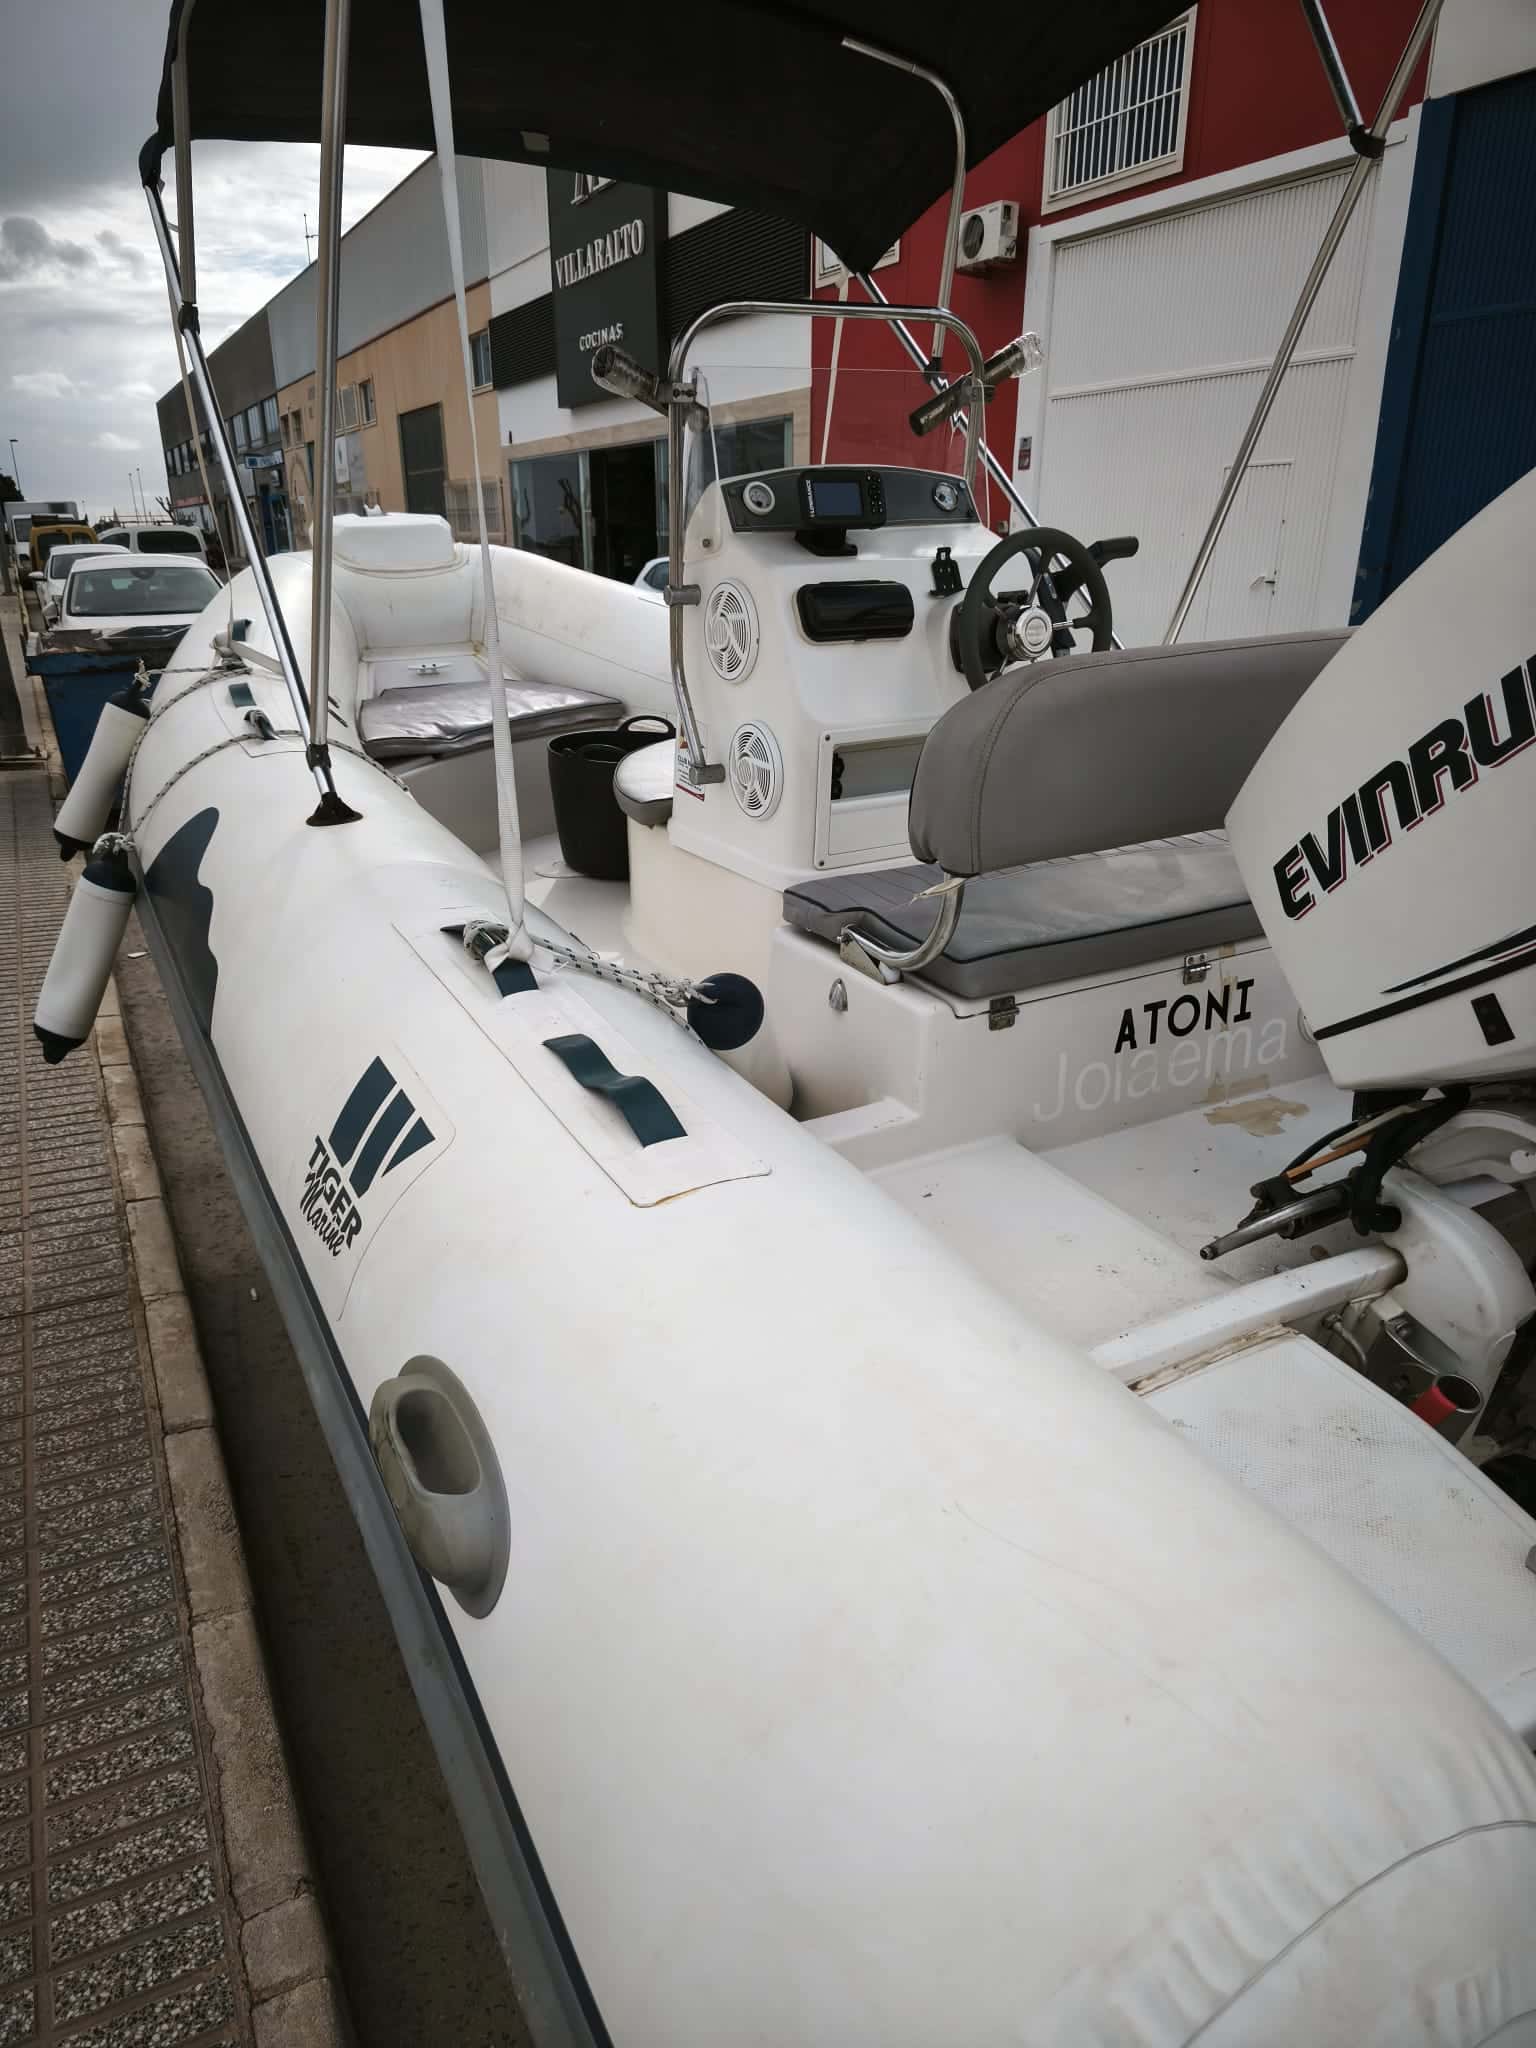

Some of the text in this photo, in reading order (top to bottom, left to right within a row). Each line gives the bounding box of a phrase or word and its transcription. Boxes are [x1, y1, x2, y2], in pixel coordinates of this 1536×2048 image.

[555, 219, 645, 288] VILLARALTO
[579, 322, 624, 351] COCINAS
[1273, 654, 1536, 921] EVINRU
[1114, 979, 1254, 1053] ATONI
[308, 1135, 362, 1250] TIGER
